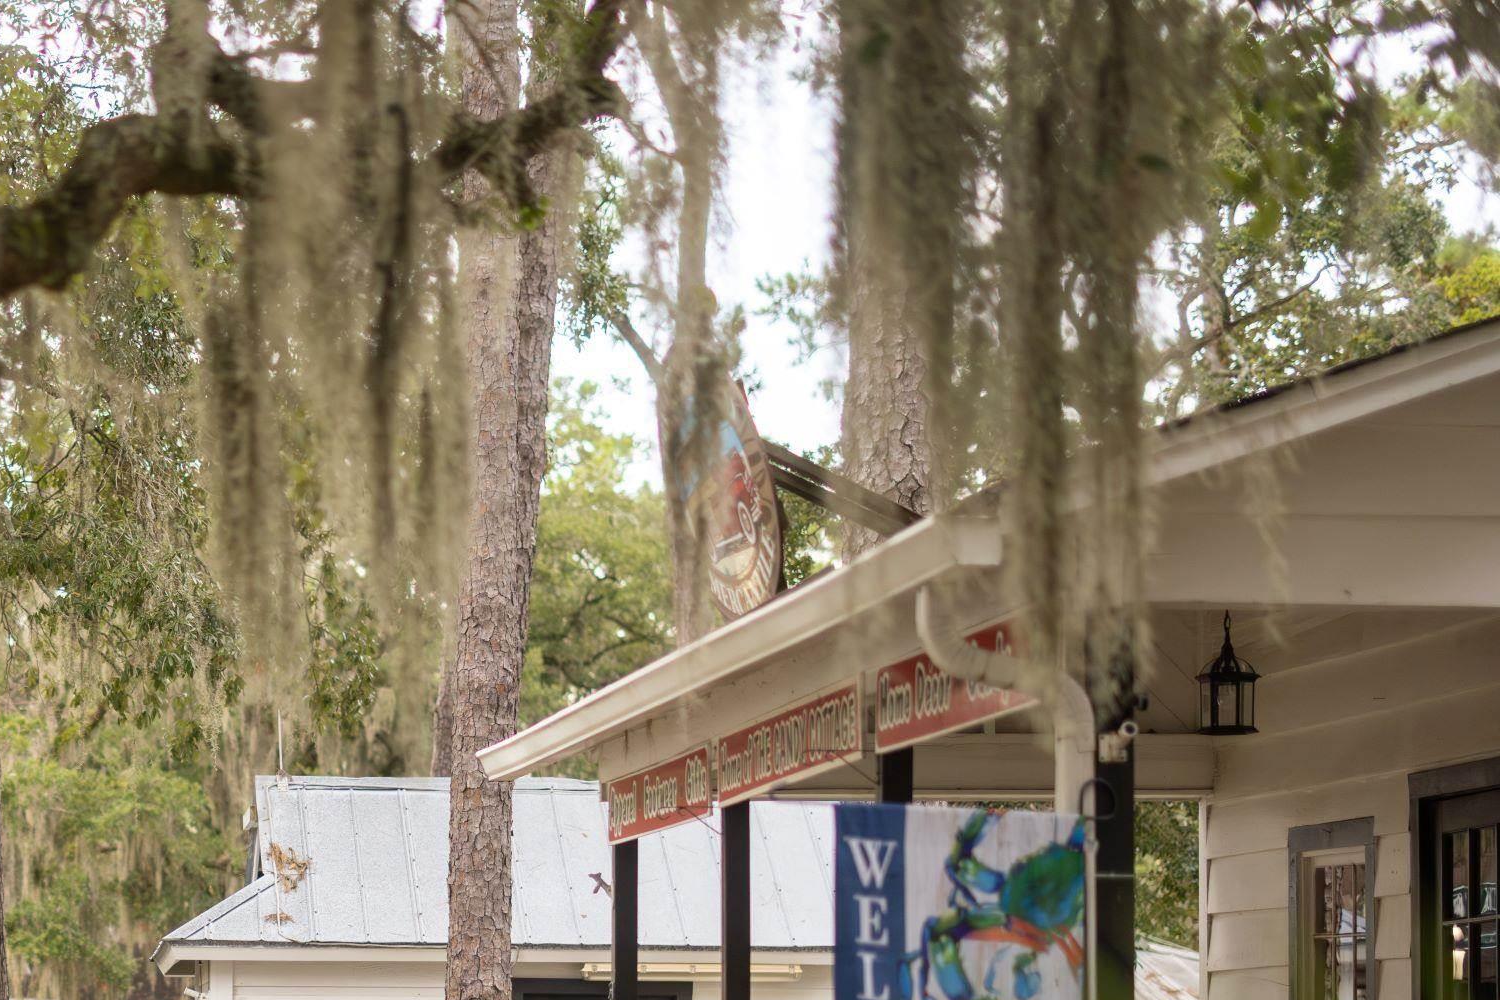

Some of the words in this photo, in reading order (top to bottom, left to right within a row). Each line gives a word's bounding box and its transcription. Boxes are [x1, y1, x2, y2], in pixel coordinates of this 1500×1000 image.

[878, 672, 911, 732] Home
[720, 741, 742, 793] Home
[753, 726, 772, 782] THE
[773, 710, 808, 775] CANDY
[808, 692, 856, 762] COTTAGE
[609, 780, 637, 838] Apparel
